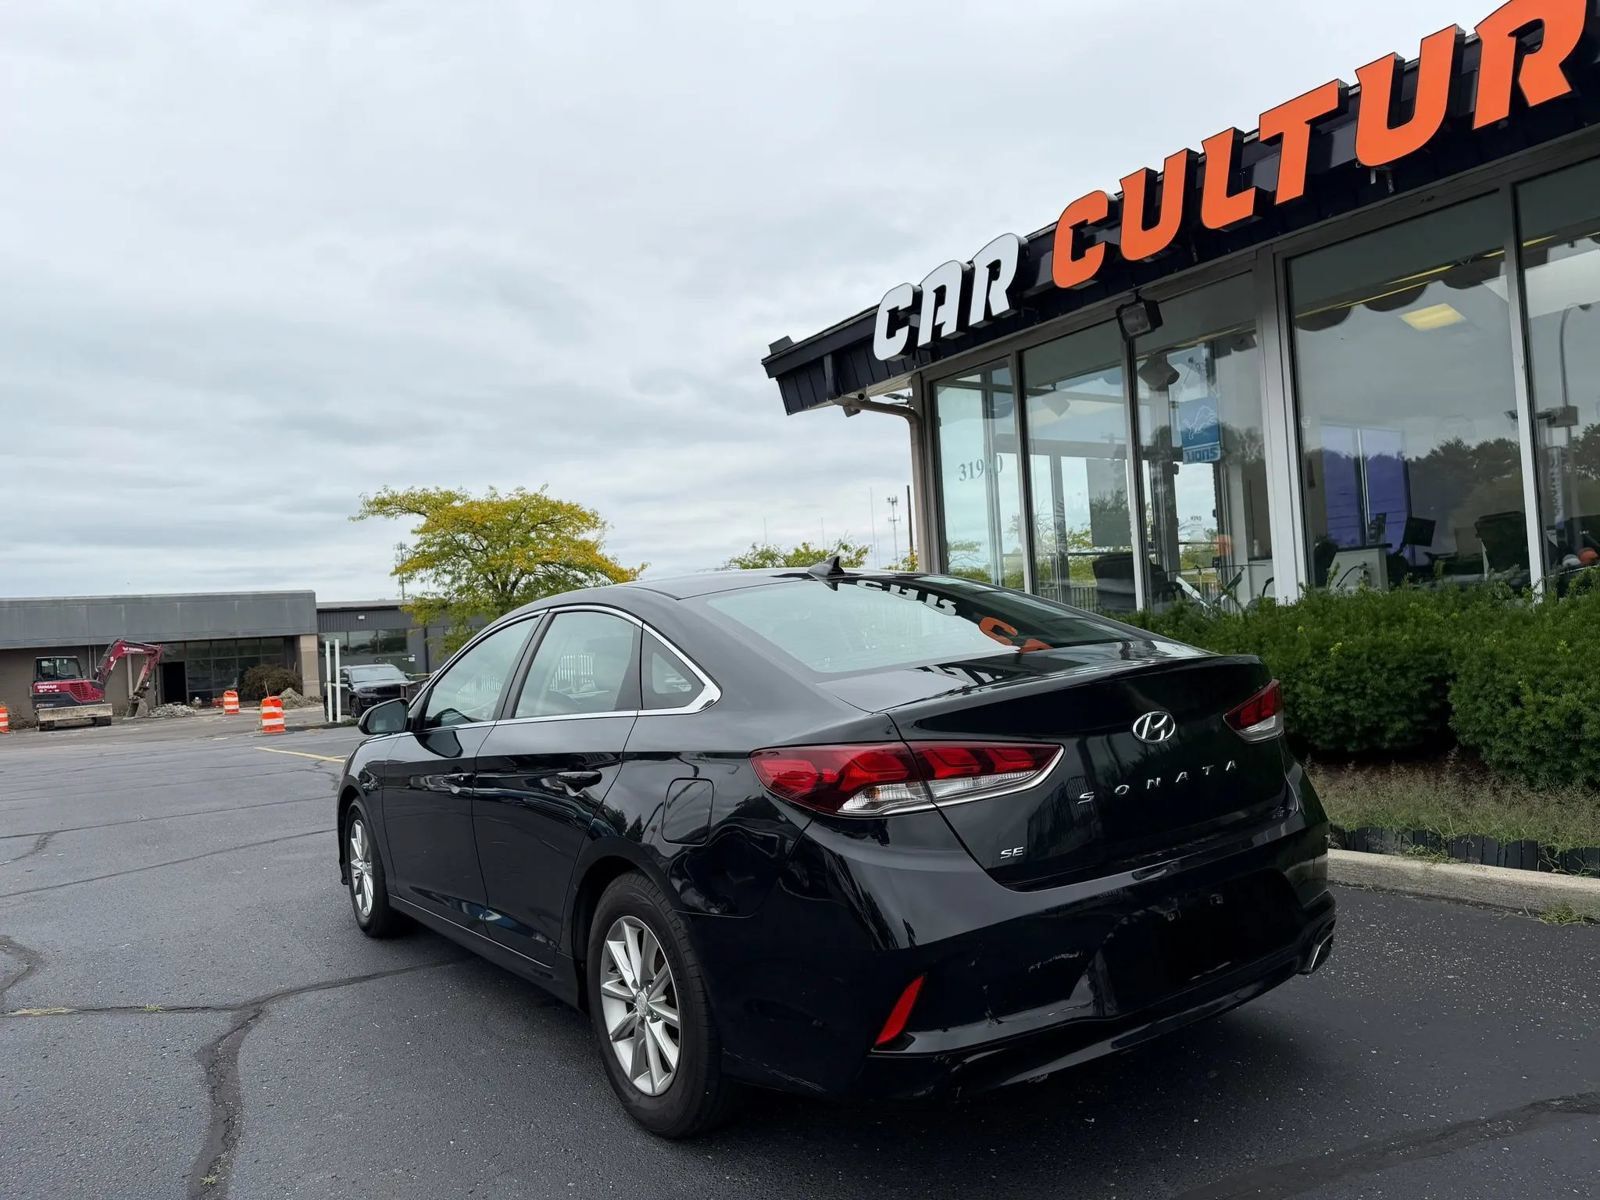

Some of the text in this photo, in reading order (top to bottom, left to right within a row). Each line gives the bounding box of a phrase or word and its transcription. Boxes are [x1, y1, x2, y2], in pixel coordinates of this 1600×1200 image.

[873, 0, 1587, 361] CAR CULTUR
[959, 454, 1003, 482] 3190
[1077, 759, 1237, 805] SONATA
[1000, 846, 1024, 859] SE
